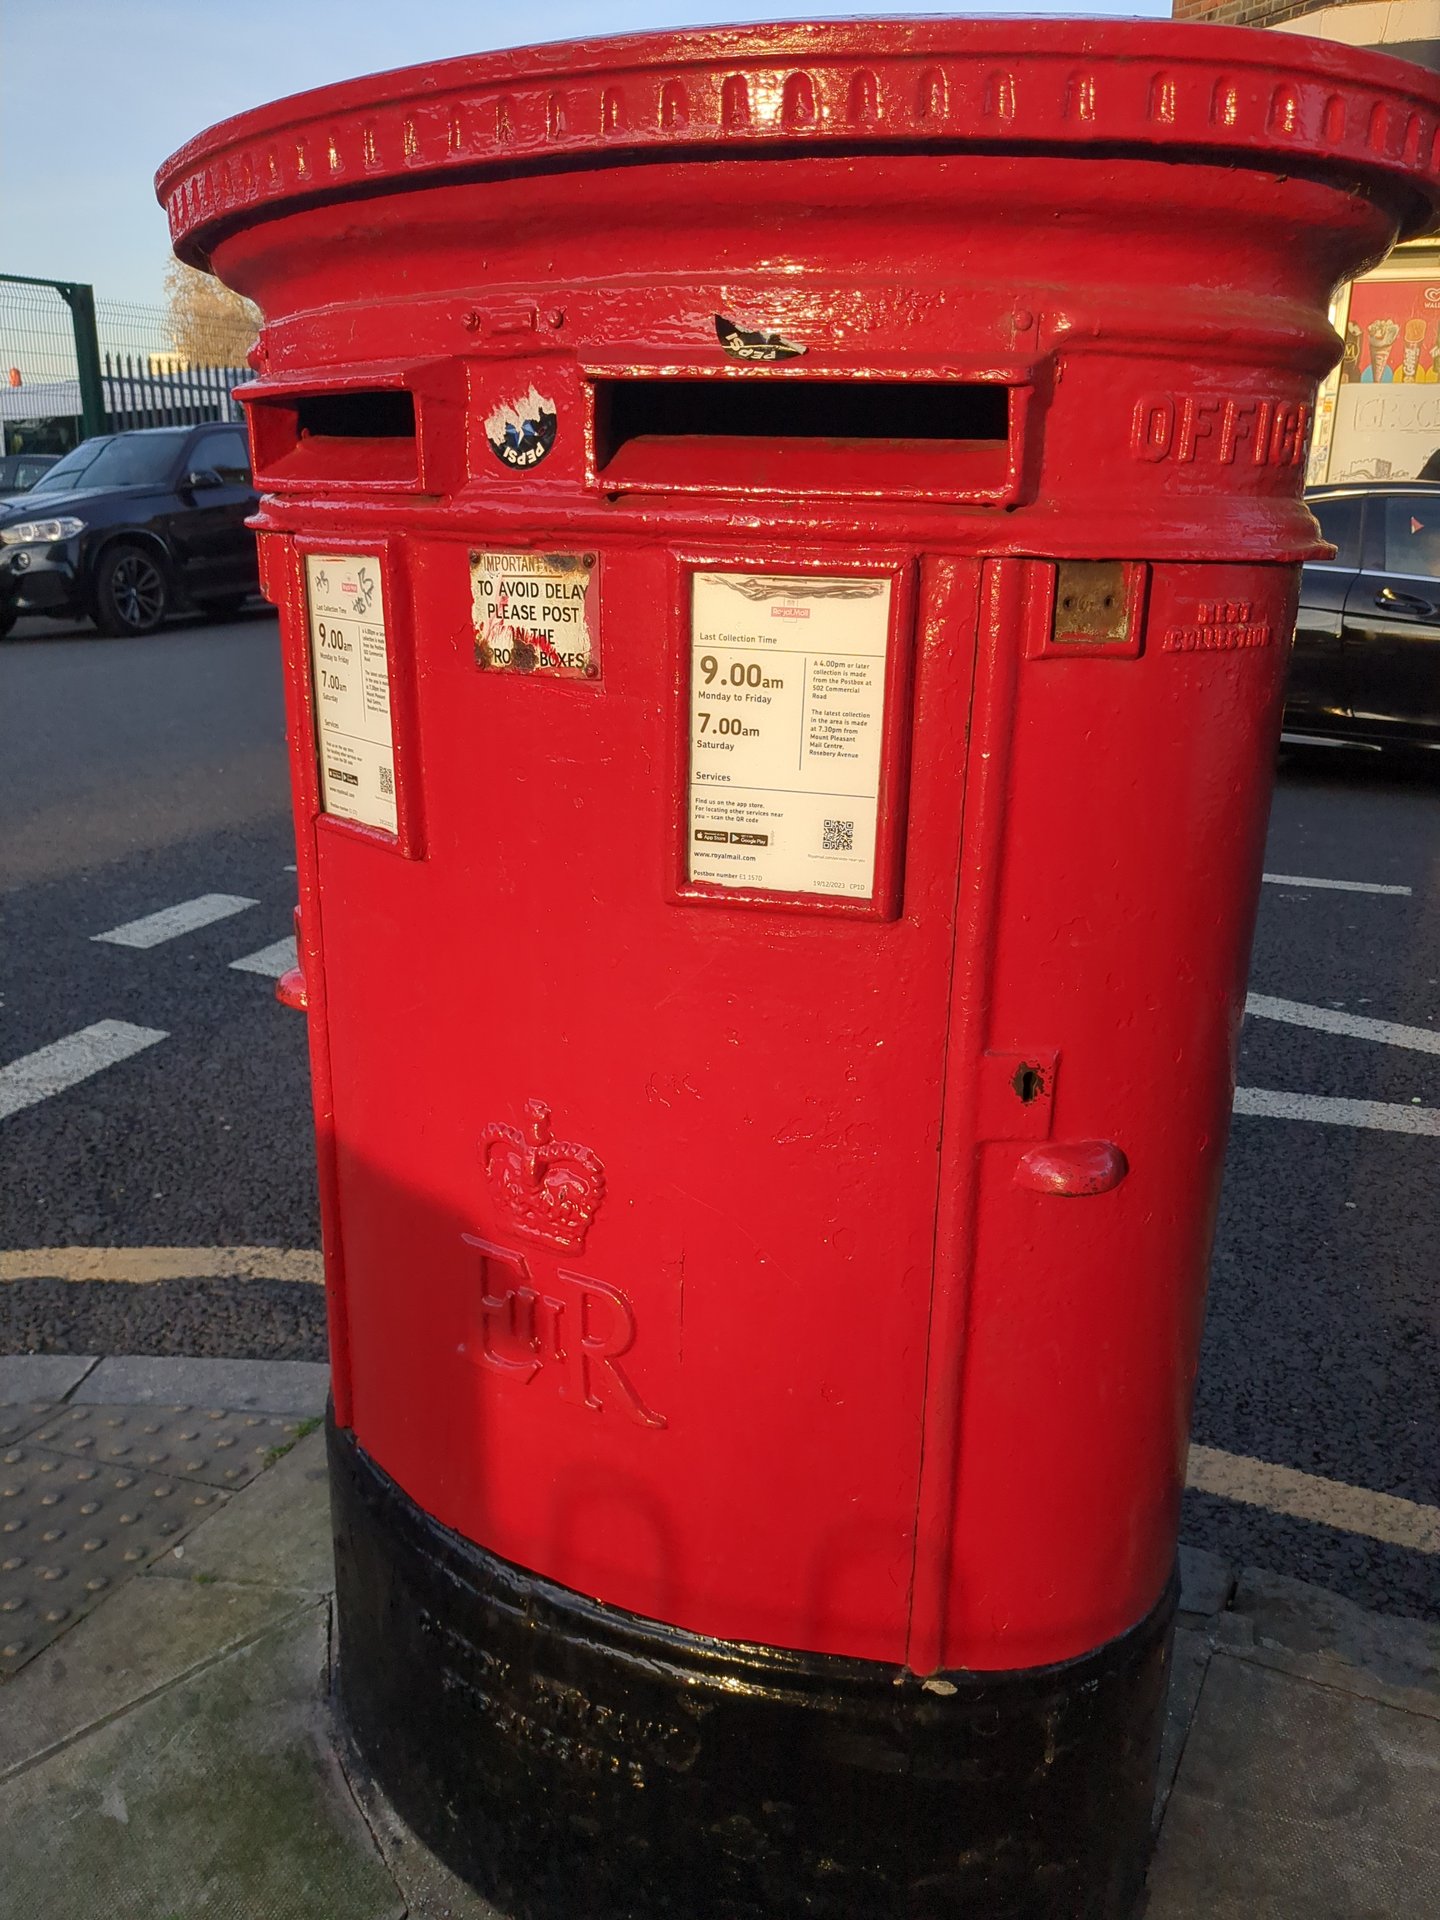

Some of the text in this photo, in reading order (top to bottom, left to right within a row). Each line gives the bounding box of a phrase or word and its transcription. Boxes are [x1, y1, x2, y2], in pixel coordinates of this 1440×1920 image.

[725, 332, 776, 360] PEPSI
[503, 442, 545, 465] PEPSI
[478, 580, 588, 600] TO AVOID DELAY
[488, 603, 579, 623] PLEASE POST
[772, 608, 809, 617] Royal Mail
[318, 623, 352, 652] 9.00am
[530, 628, 555, 645] THE
[719, 634, 755, 643] Collection
[759, 636, 777, 644] Time
[540, 651, 585, 668] BOXES
[819, 661, 845, 669] 4.00pm
[700, 656, 784, 689] 9.00am
[321, 670, 347, 692] 7.00am
[699, 691, 730, 702] Monday
[745, 694, 772, 704] Friday
[324, 718, 339, 729] Services
[698, 713, 759, 737] 7.00am
[697, 740, 734, 751] Saturday
[696, 772, 731, 781] Services
[706, 806, 728, 814] locating
[694, 852, 756, 862] www.royalmail.com
[813, 880, 845, 888] 19/12/2023
